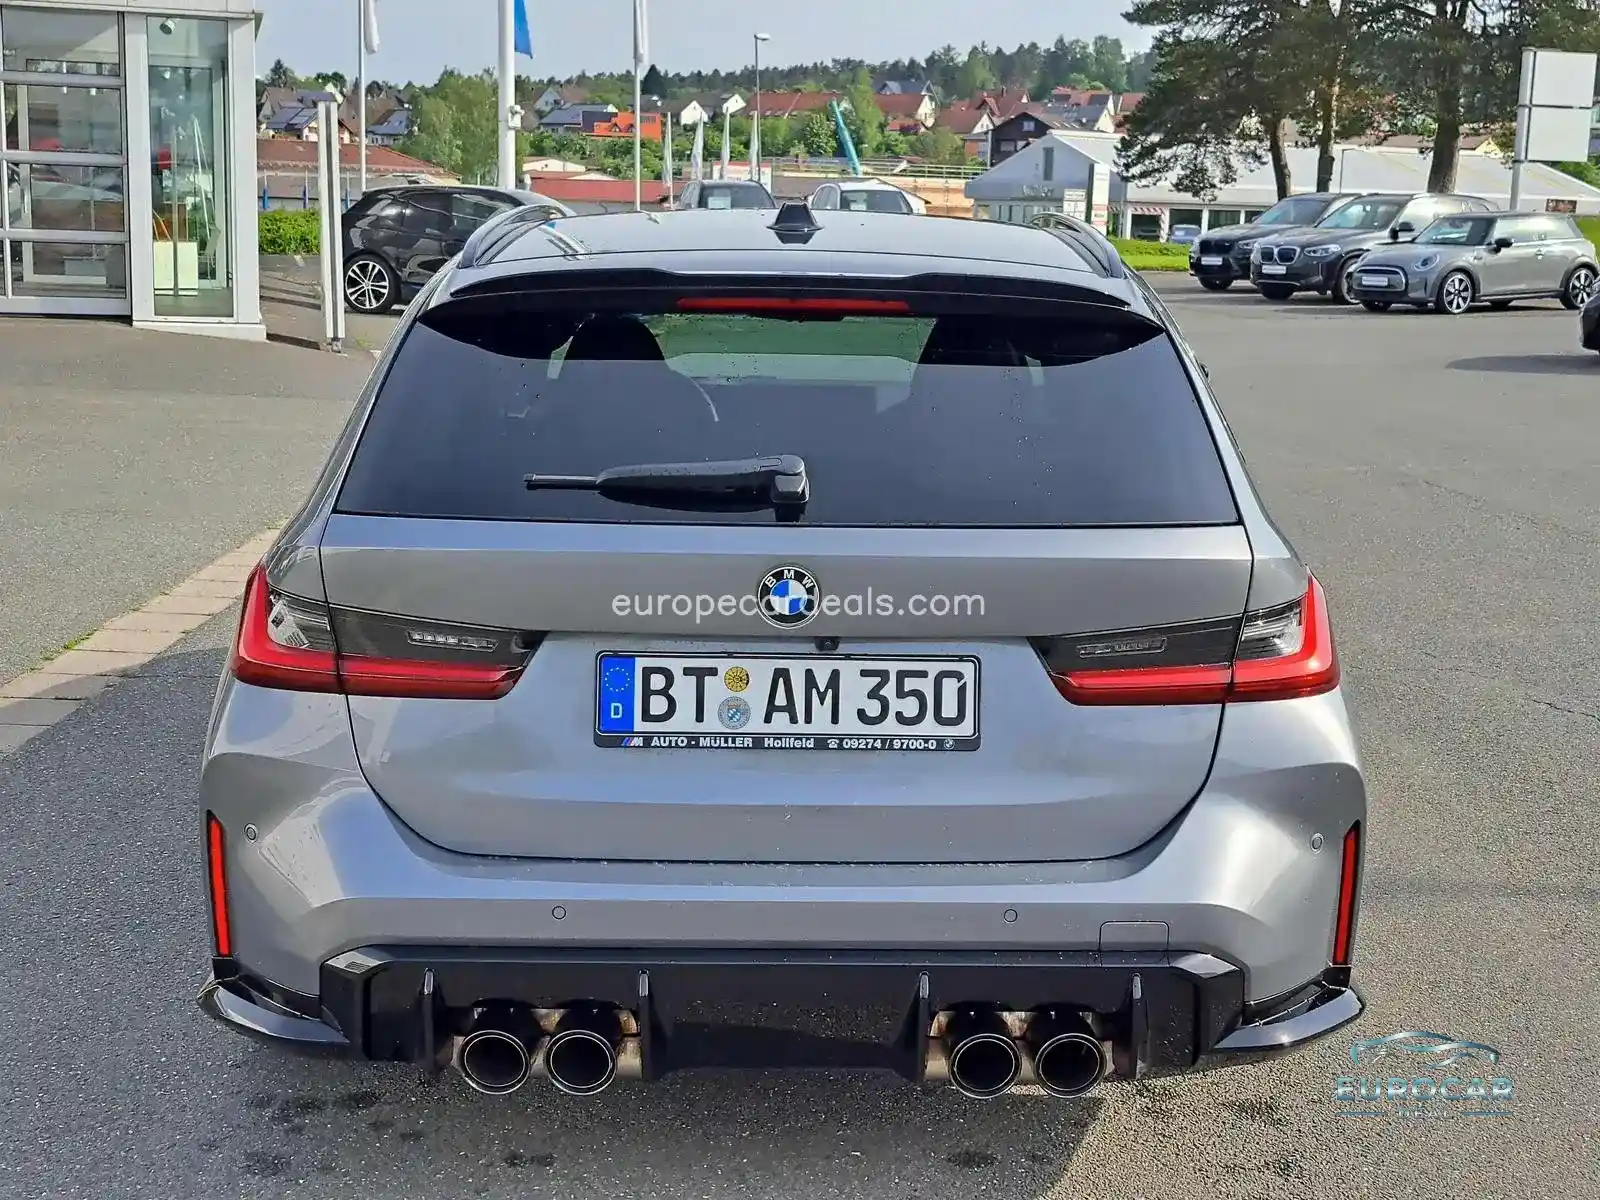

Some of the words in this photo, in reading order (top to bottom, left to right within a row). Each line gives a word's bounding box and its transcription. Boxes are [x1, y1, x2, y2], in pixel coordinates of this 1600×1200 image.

[764, 569, 814, 588] BMW
[641, 666, 719, 723] BT
[764, 667, 841, 725] AM
[856, 668, 967, 727] 350
[610, 702, 624, 719] D
[650, 736, 688, 747] AUTO
[699, 736, 753, 747] MÜLLER
[763, 737, 815, 748] Hollfeld
[842, 738, 882, 749] 09274
[892, 739, 937, 750] 9700-0
